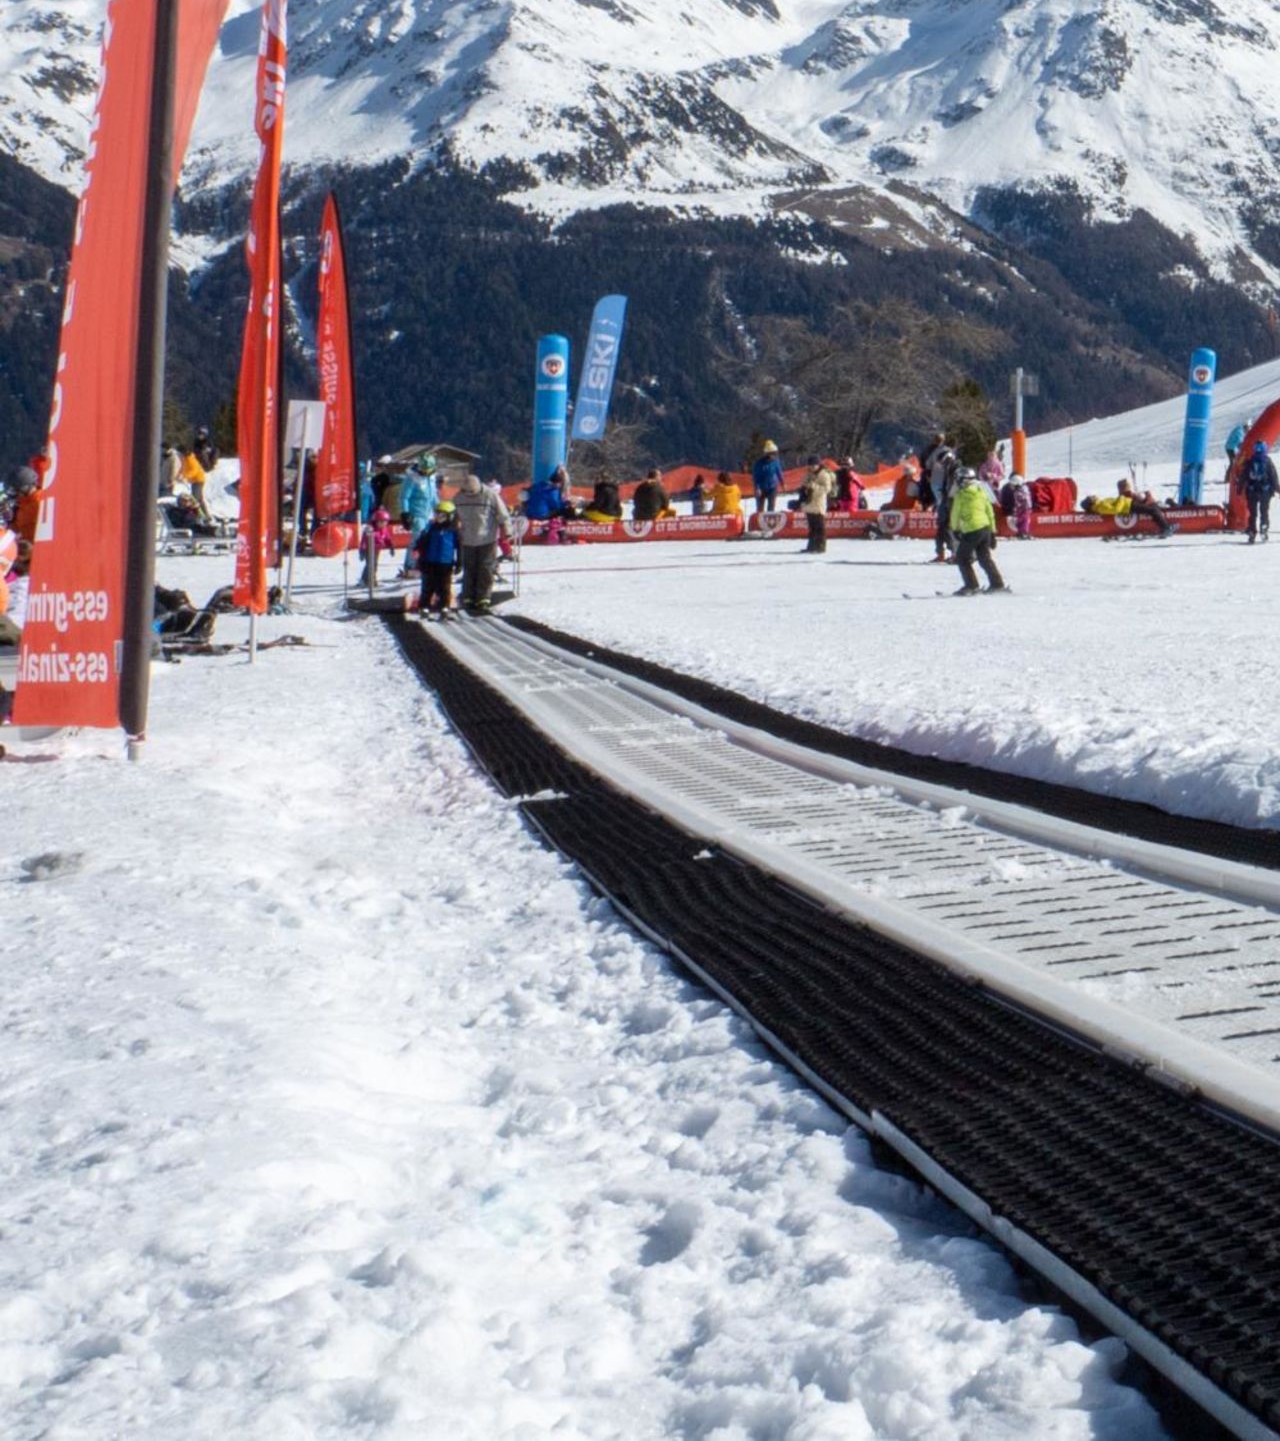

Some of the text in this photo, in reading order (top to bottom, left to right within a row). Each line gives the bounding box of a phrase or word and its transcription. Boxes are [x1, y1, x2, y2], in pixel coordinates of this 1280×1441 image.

[588, 333, 615, 391] SKI
[1037, 515, 1059, 524] SWISS
[1061, 515, 1073, 523] SKI
[680, 520, 727, 531] SNOWBOARD
